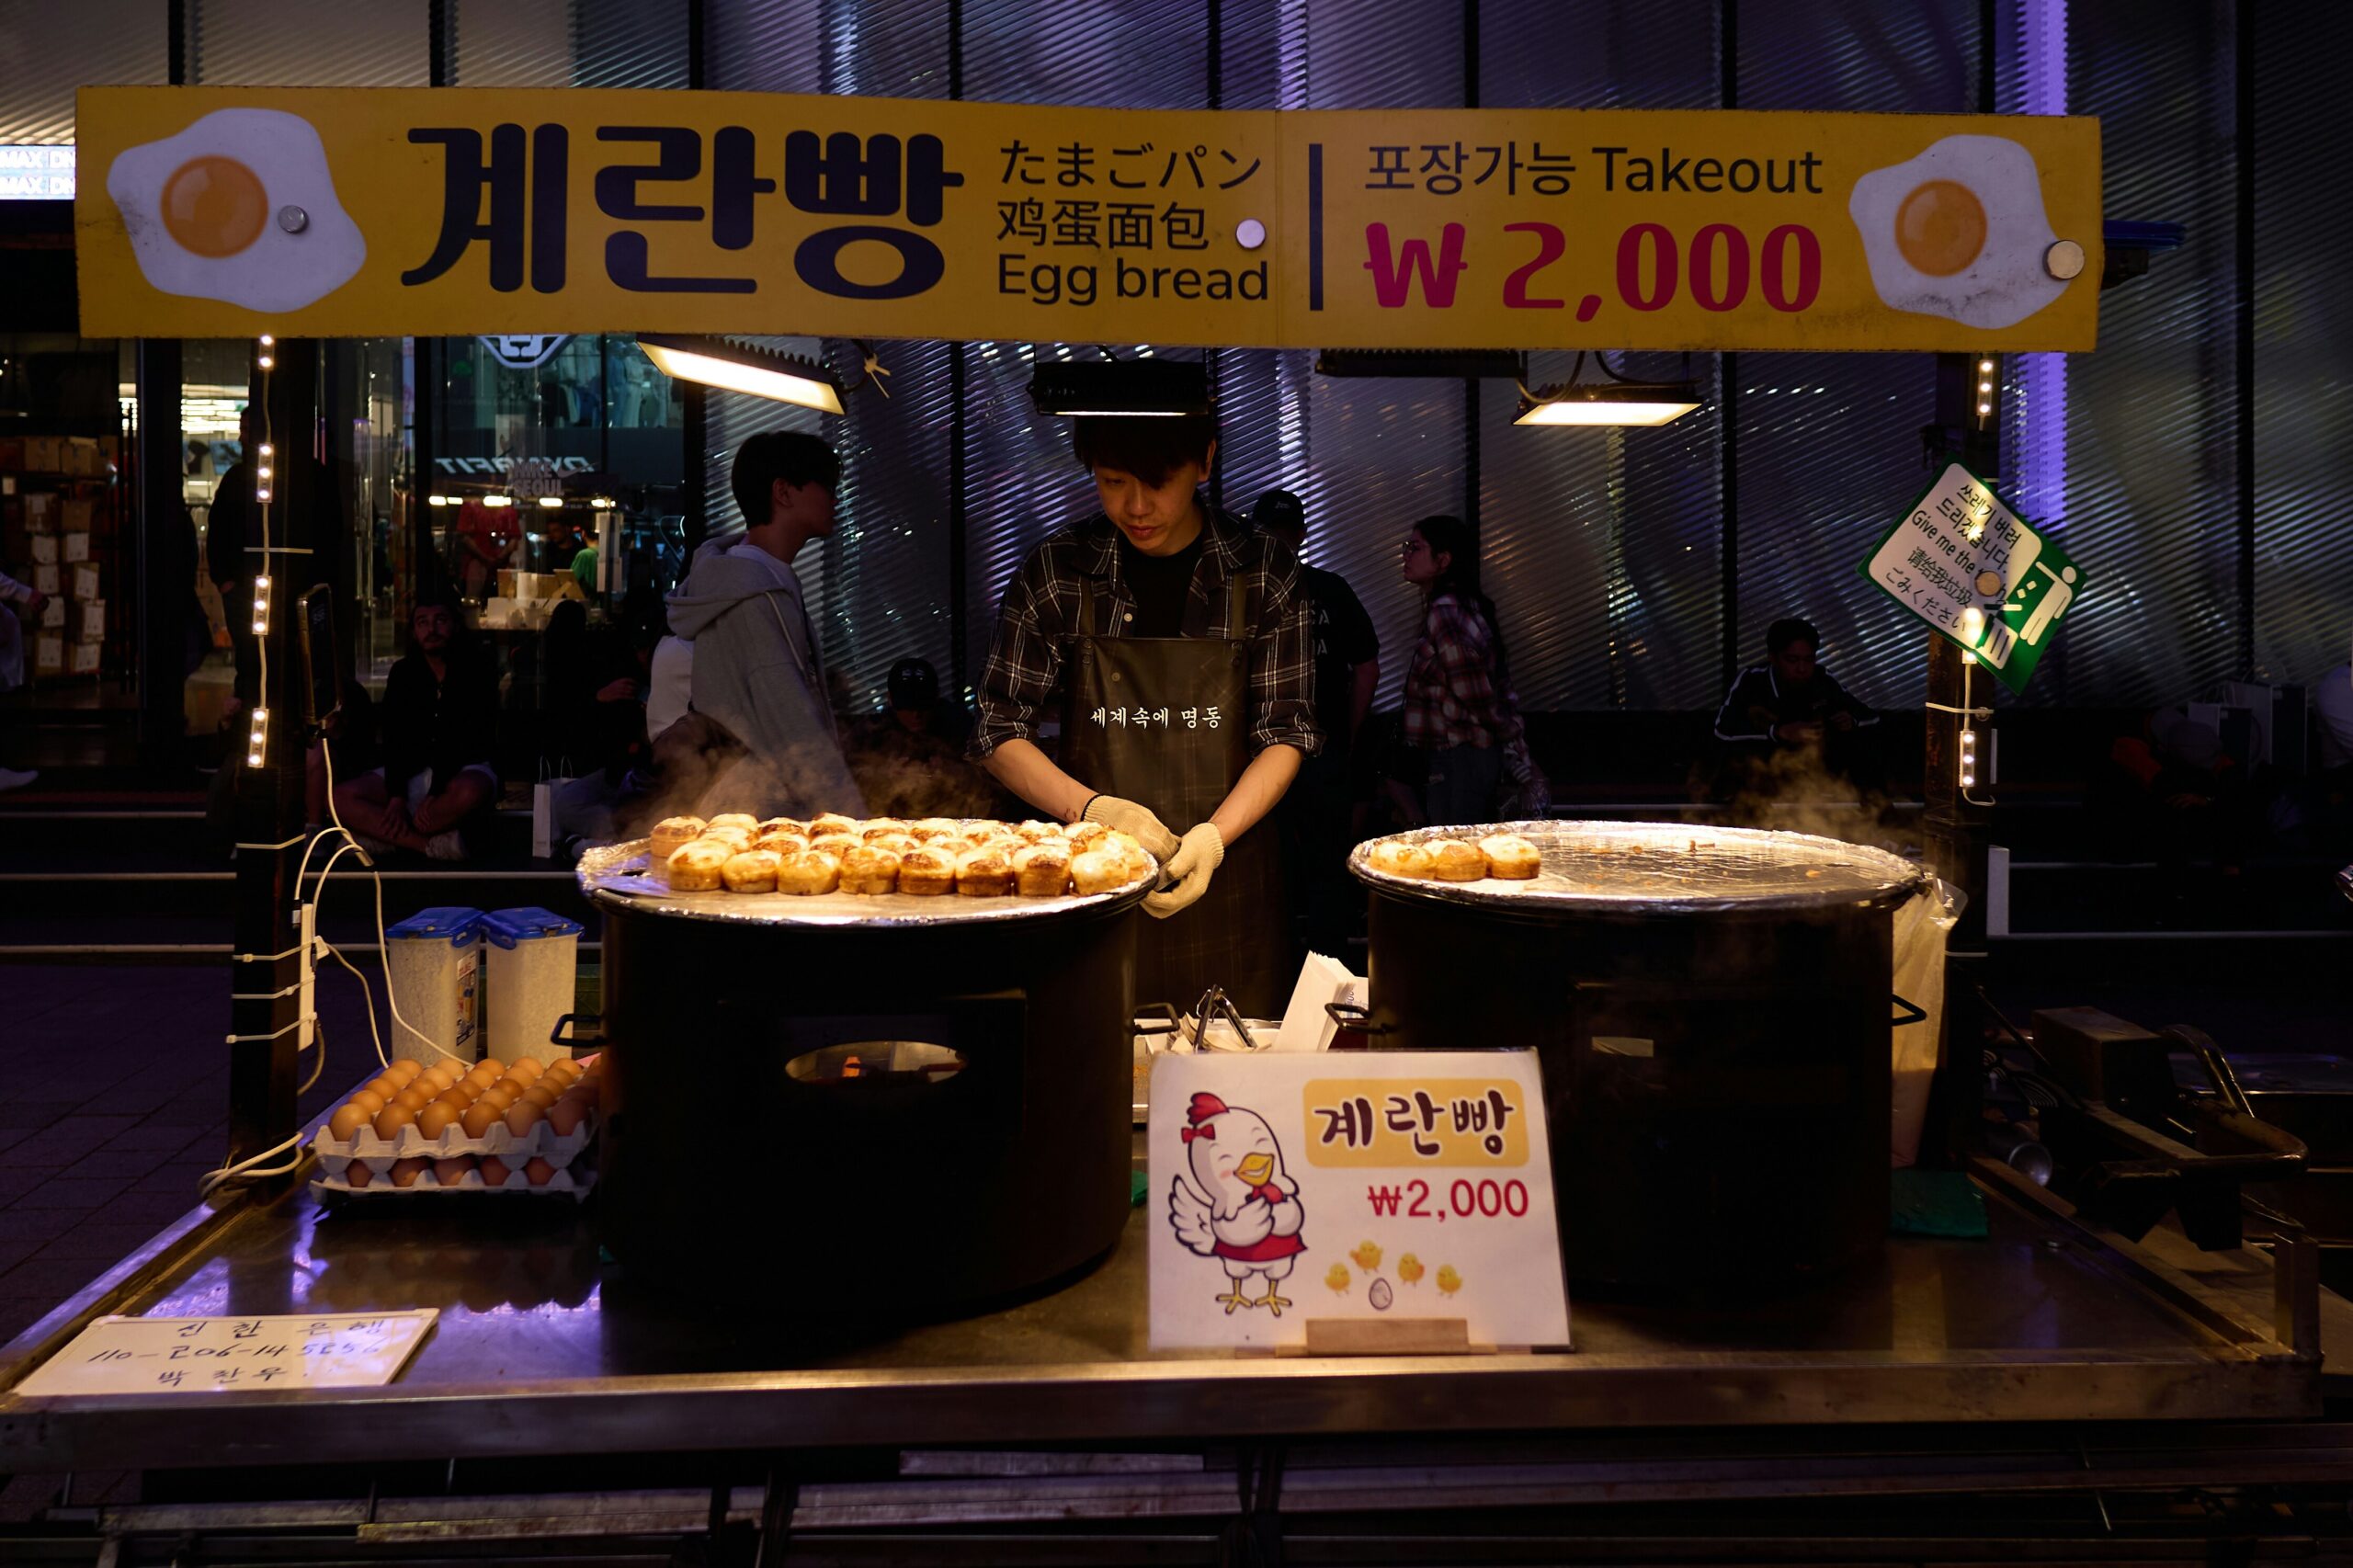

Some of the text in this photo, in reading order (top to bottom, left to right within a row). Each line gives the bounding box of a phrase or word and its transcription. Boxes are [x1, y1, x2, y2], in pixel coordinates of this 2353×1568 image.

[999, 140, 1262, 190] たまごパン
[1366, 142, 1824, 197] 포장가능 Takeout
[402, 123, 965, 301] 계란빵
[998, 198, 1210, 252] 鸡蛋面包
[999, 254, 1268, 307] Egg bread
[1911, 509, 1976, 574] Give me the
[1957, 484, 2022, 551] 쓰레기 버려
[1885, 566, 1967, 632] ごみください
[1907, 545, 1973, 609] 请给我垃圾
[1090, 707, 1222, 730] 세계속에 명동
[1314, 1090, 1515, 1156] 계란빵
